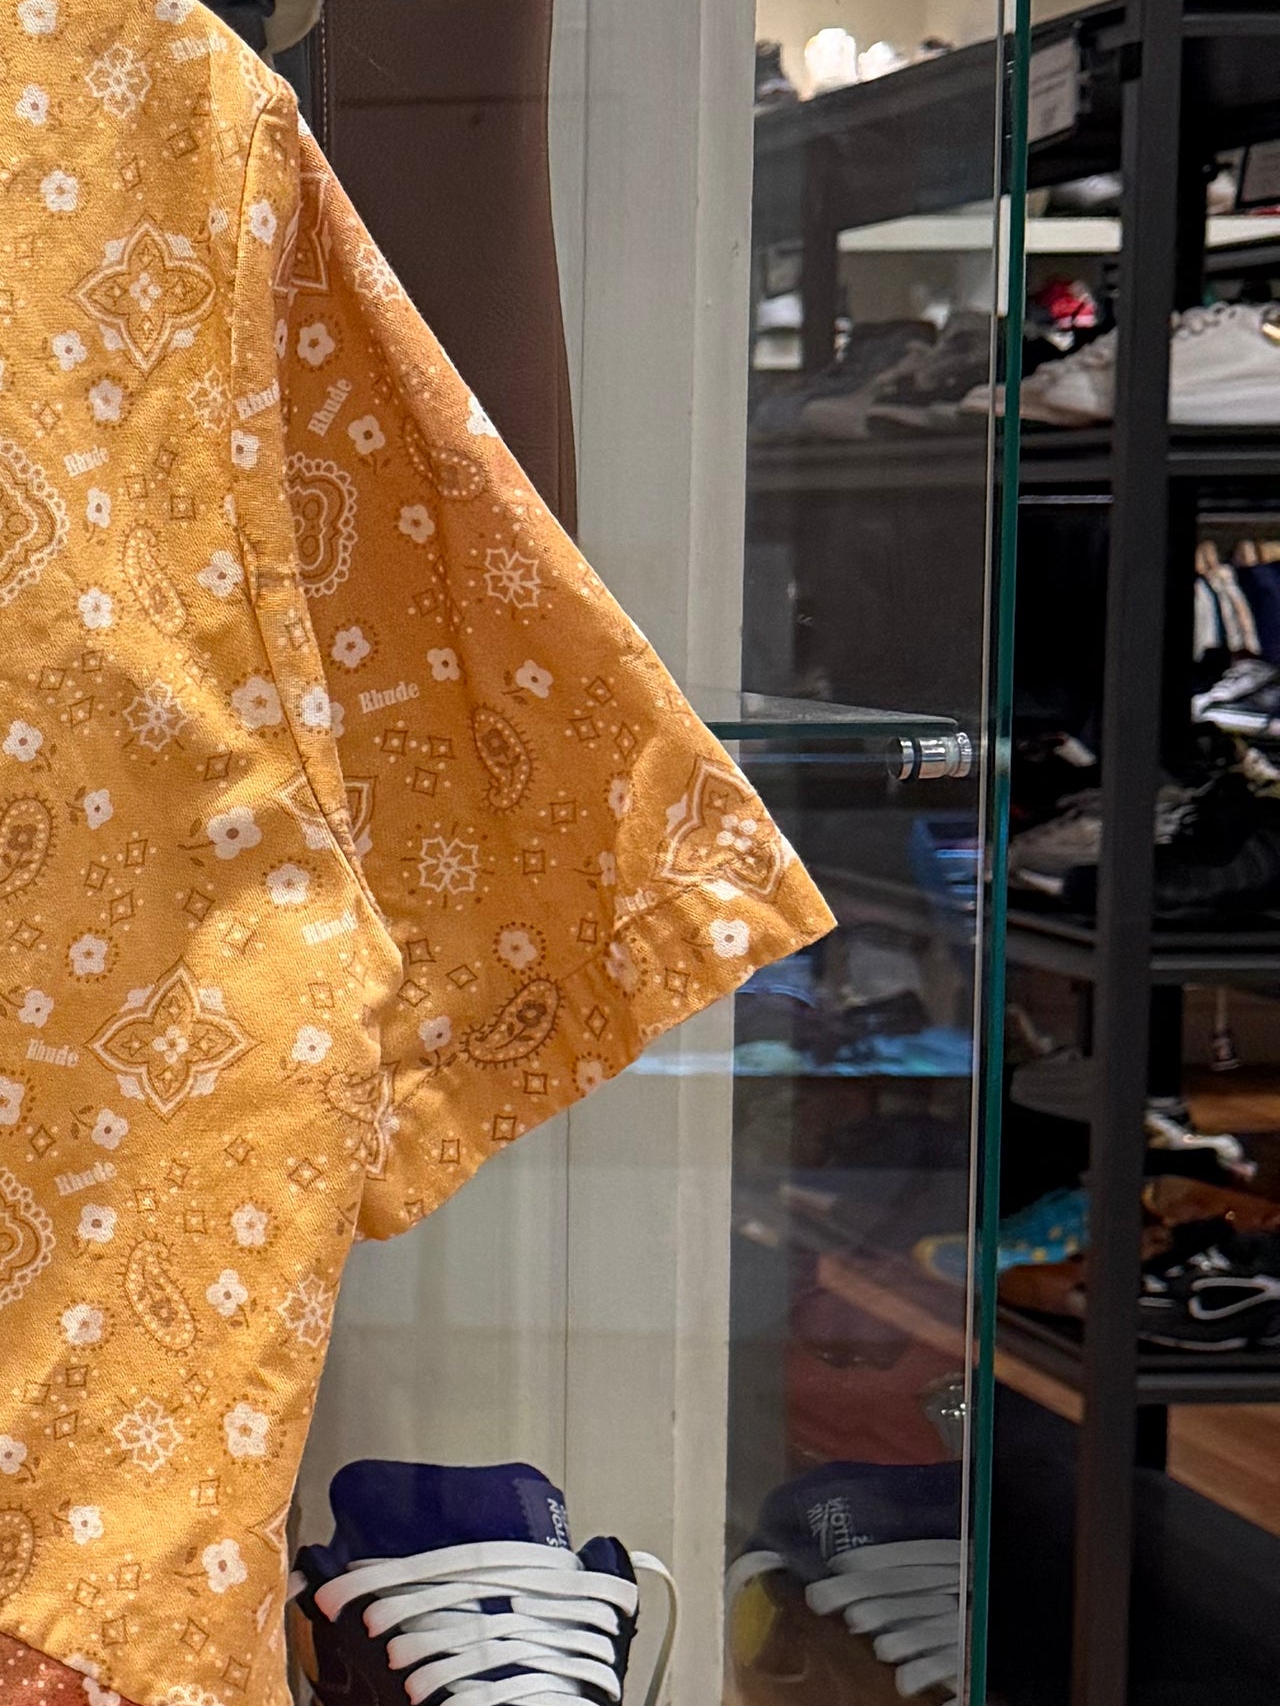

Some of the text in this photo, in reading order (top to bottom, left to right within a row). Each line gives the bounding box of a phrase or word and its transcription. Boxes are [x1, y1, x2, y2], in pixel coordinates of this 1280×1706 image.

[308, 378, 352, 436] Rhude
[63, 445, 112, 477] Rhude
[358, 680, 420, 714] Rhude
